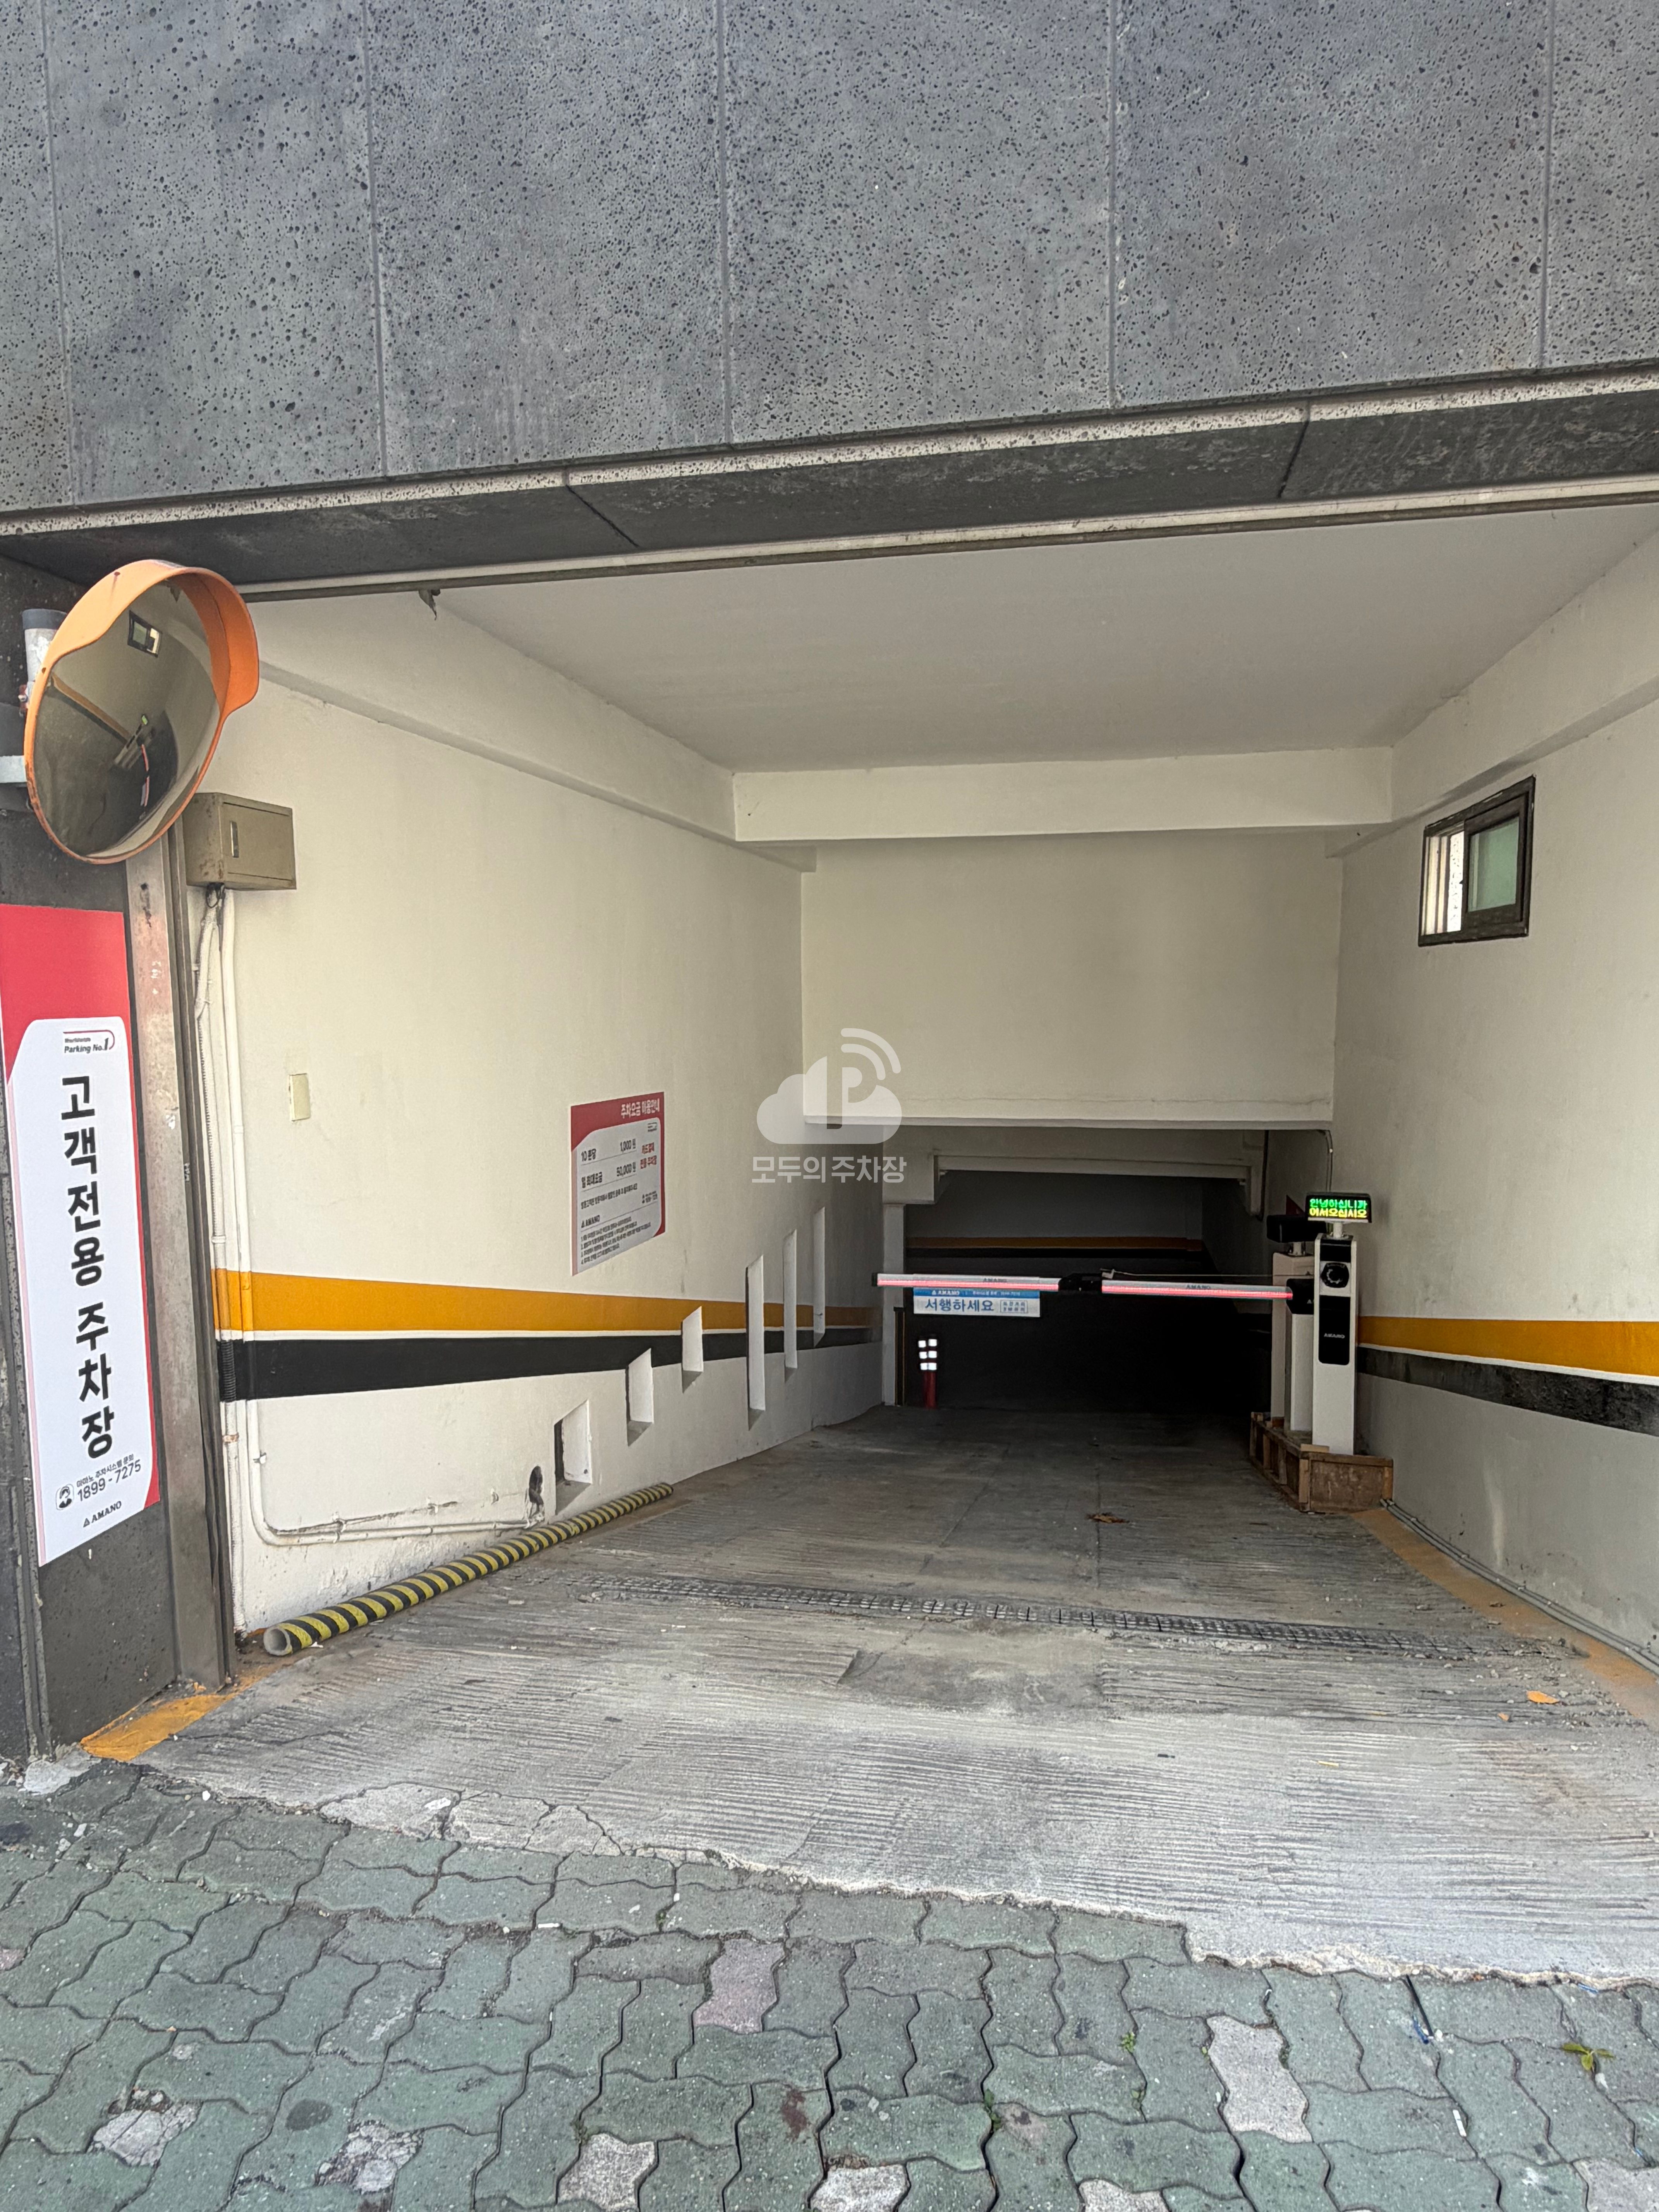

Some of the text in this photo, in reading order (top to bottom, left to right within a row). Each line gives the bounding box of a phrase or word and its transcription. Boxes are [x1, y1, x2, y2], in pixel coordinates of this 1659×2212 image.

[61, 1076, 104, 1286] 고객전용
[1309, 1207, 1367, 1218] 어서오십시오
[1310, 1199, 1368, 1209] 안녕하십니까
[925, 1298, 994, 1312] 서행하세요
[76, 1302, 114, 1458] 주차장
[77, 1478, 106, 1502] 1899
[115, 1459, 141, 1484] 7275
[91, 1501, 122, 1523] AMANO
